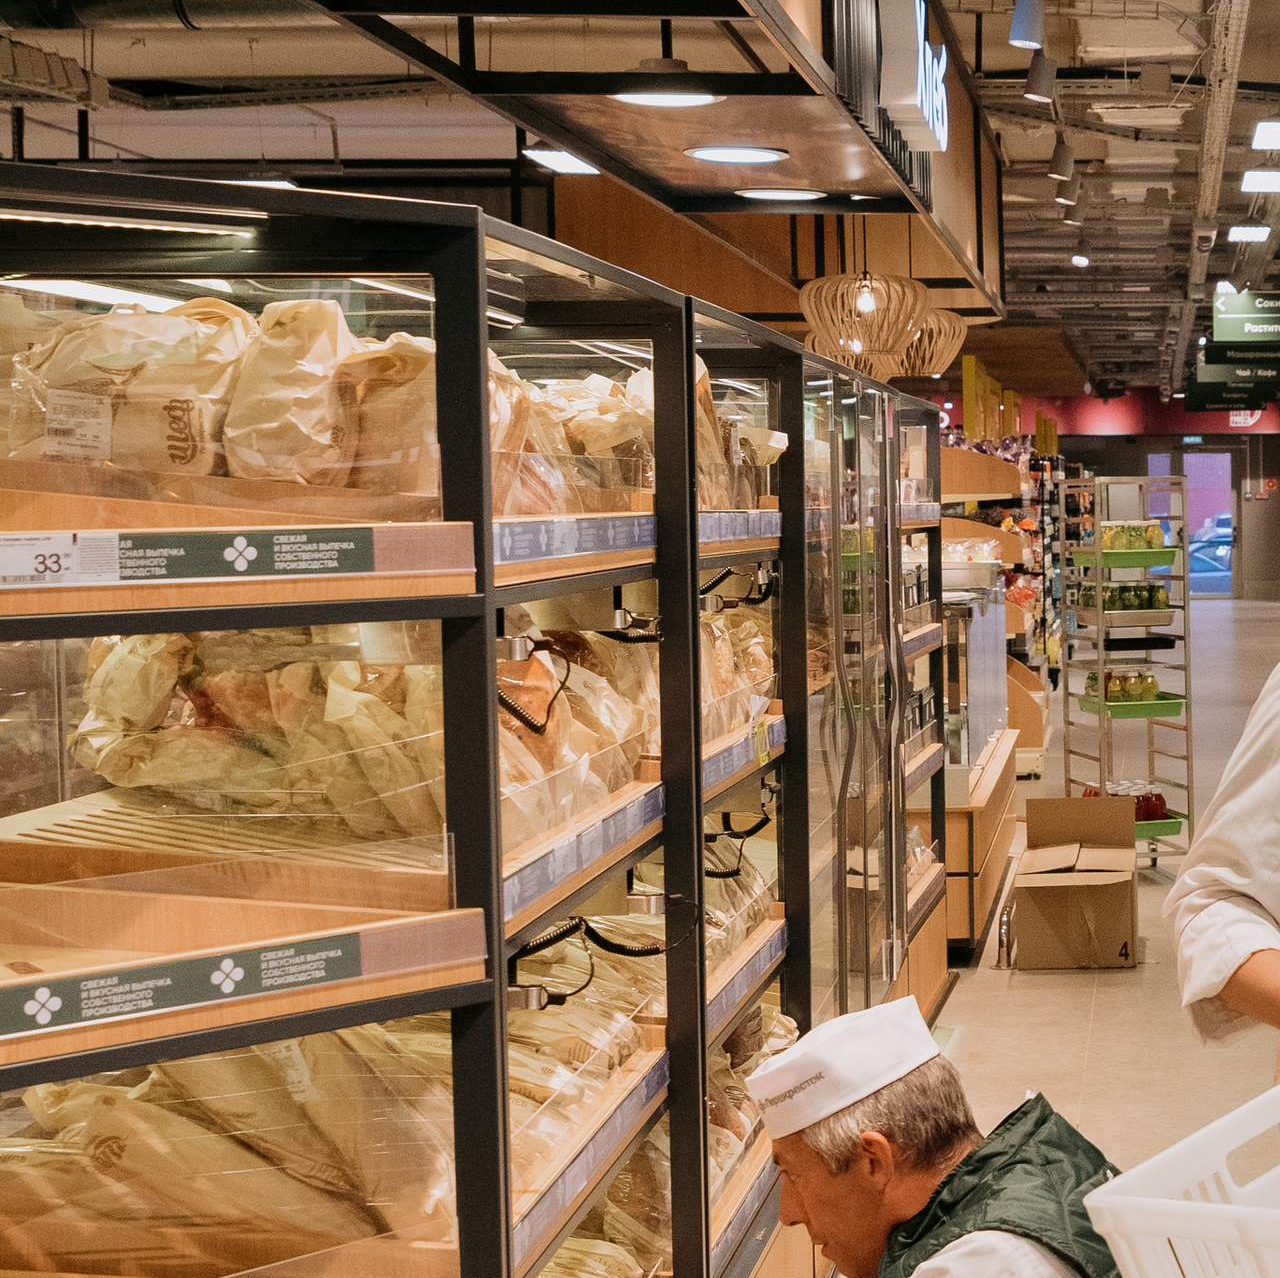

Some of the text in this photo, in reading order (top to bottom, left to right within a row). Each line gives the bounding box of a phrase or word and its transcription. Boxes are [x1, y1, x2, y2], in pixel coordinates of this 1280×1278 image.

[273, 534, 307, 543] СВЕЖАЯ
[119, 549, 145, 558] СНАЯ
[281, 543, 318, 552] ВКУСНАЯ
[319, 542, 355, 550] ВЫПЕЧКА
[119, 558, 167, 567] ТВЕННОГО
[274, 551, 338, 561] СОБСТВЕННОГО
[34, 553, 62, 574] 33
[274, 560, 339, 570] ПРОИЗВОДСТВА
[119, 567, 167, 577] ЗВОДСТВА
[260, 948, 295, 961] СВЕЖАЯ
[1118, 941, 1130, 961] 4
[268, 955, 306, 969] ВКУСНАЯ
[306, 949, 342, 962] ВЫПЕЧКА
[261, 960, 326, 979] СОБСТВЕННОГО
[80, 976, 119, 990] СВЕЖАЯ
[261, 969, 326, 988] ПРОИЗВОДСТВА
[89, 983, 130, 998] ВКУСНАЯ
[131, 977, 172, 991] ВЫПЕЧКА
[81, 990, 153, 1009] СОБСТВЕННОГО
[81, 999, 154, 1018] ПРОИЗВОДСТВА
